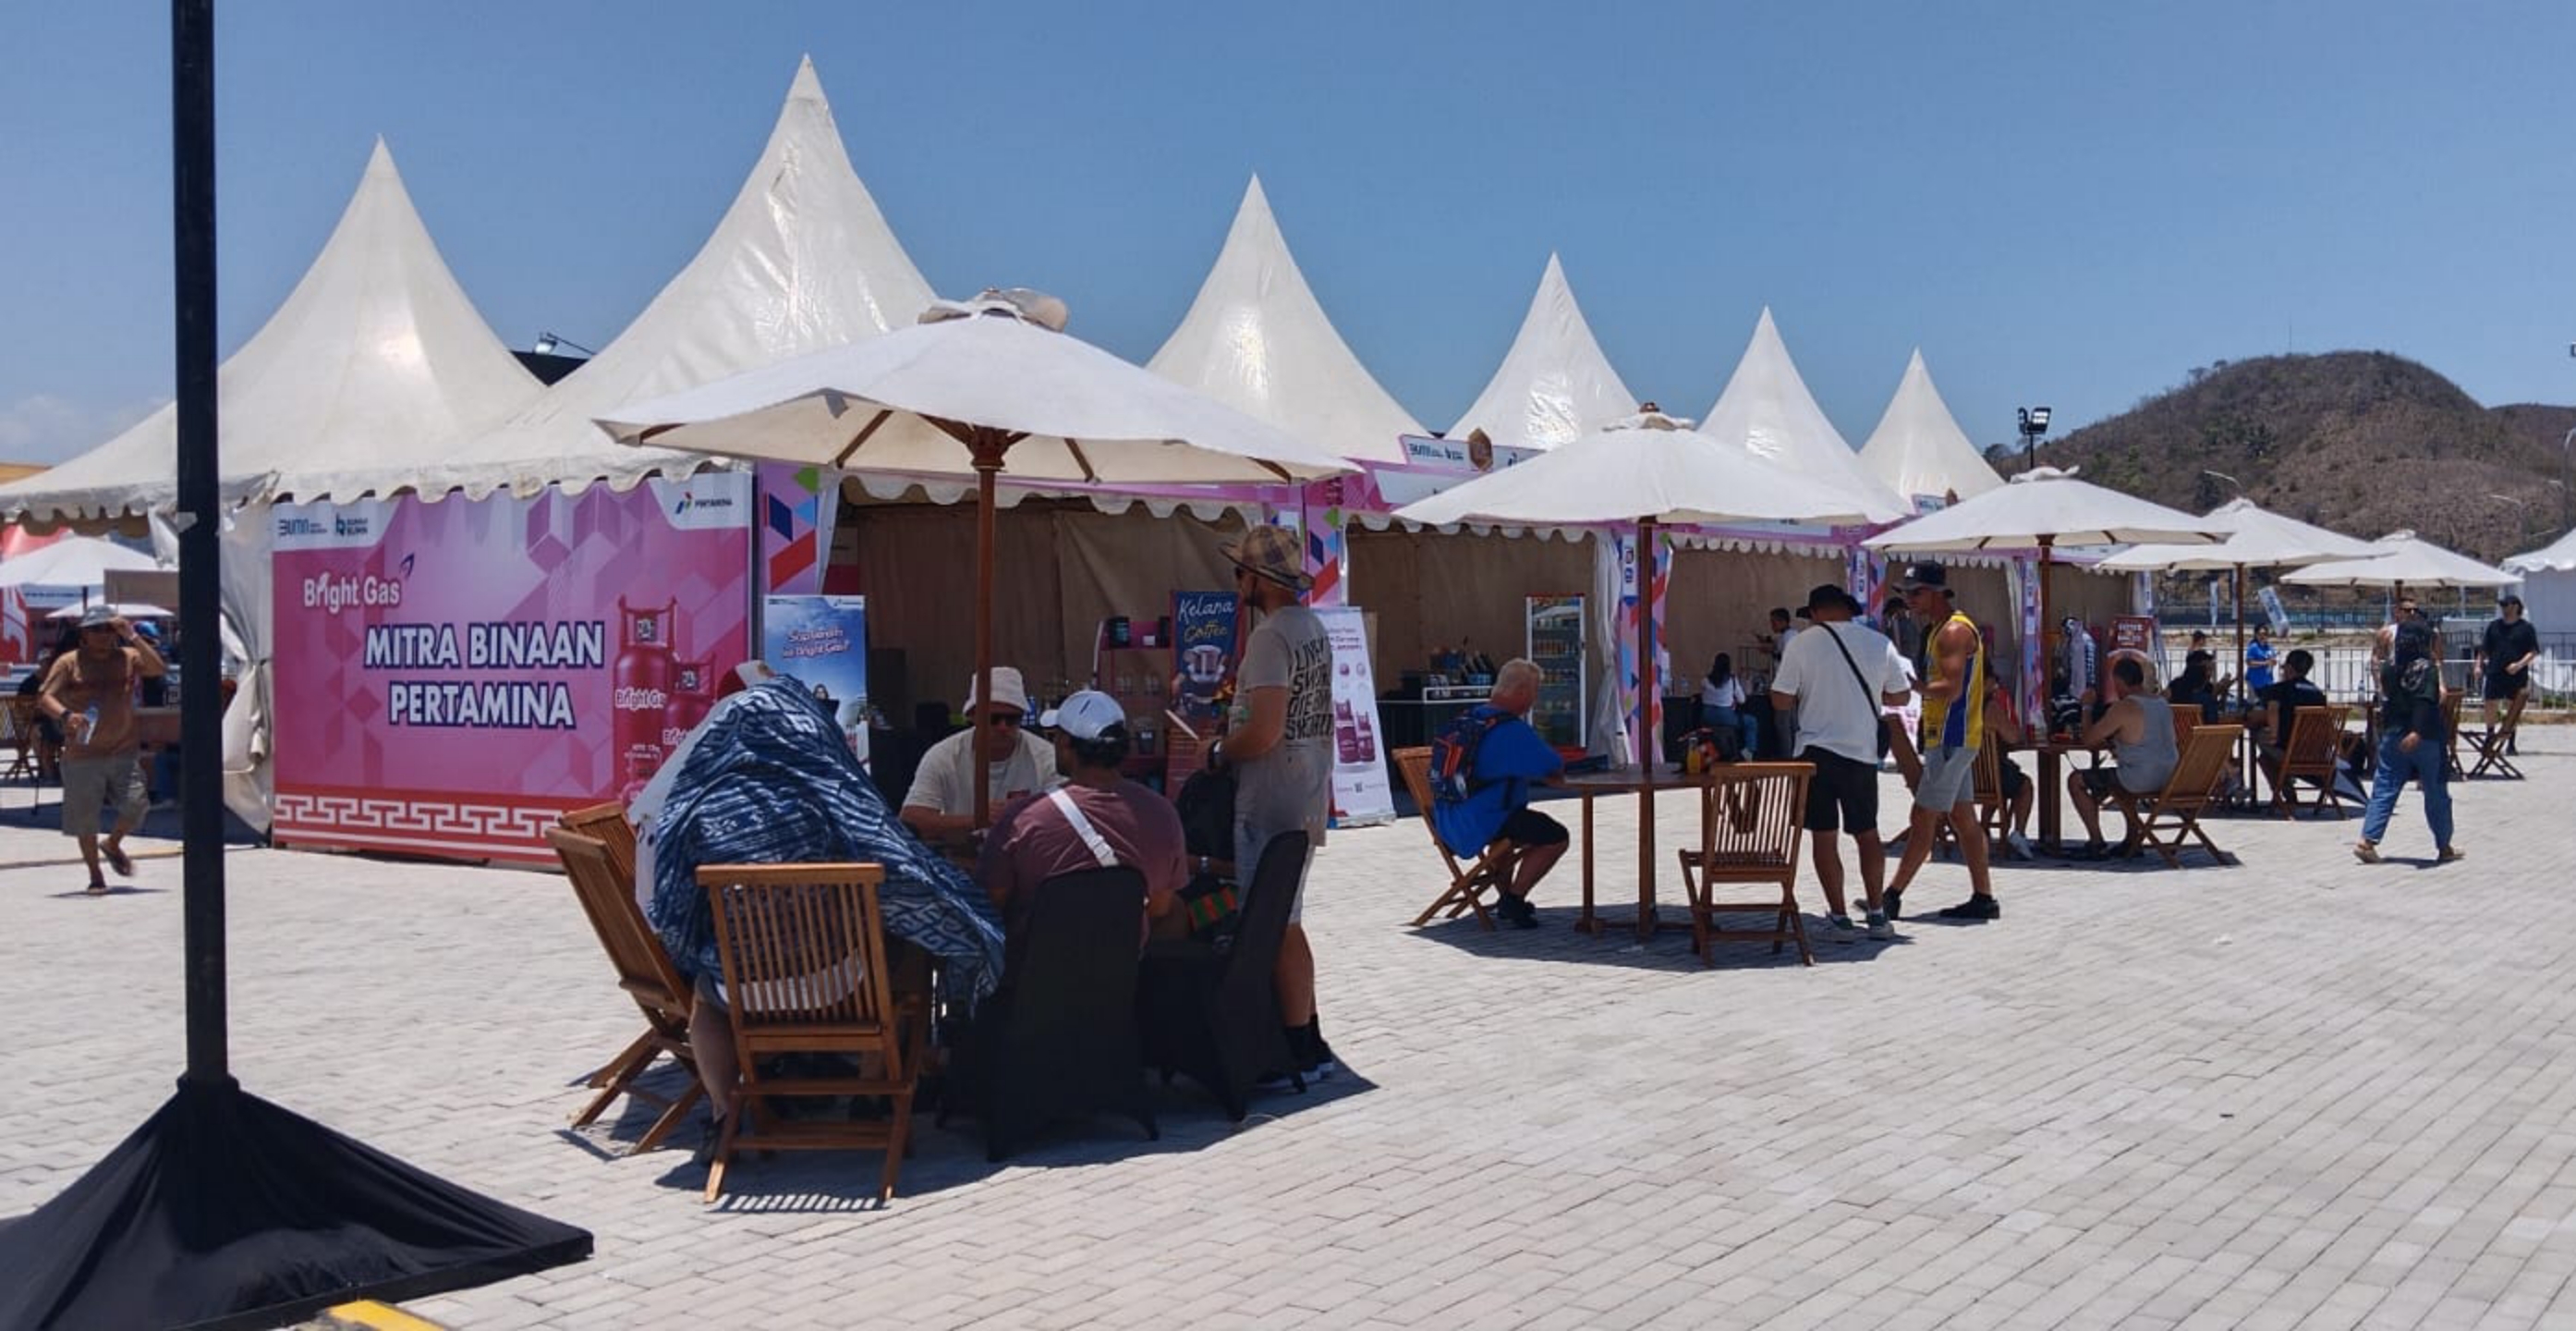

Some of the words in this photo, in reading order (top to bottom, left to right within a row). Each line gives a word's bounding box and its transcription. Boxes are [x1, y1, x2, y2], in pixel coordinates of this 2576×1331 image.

[304, 571, 360, 615] Bright
[363, 575, 401, 605] Gas
[1178, 595, 1235, 625] Kelana
[364, 623, 460, 668] MITRA
[468, 621, 604, 668] BINAAN
[1184, 619, 1228, 643] Coffee
[389, 680, 577, 729] PERTAMINA
[615, 687, 650, 712] Bright
